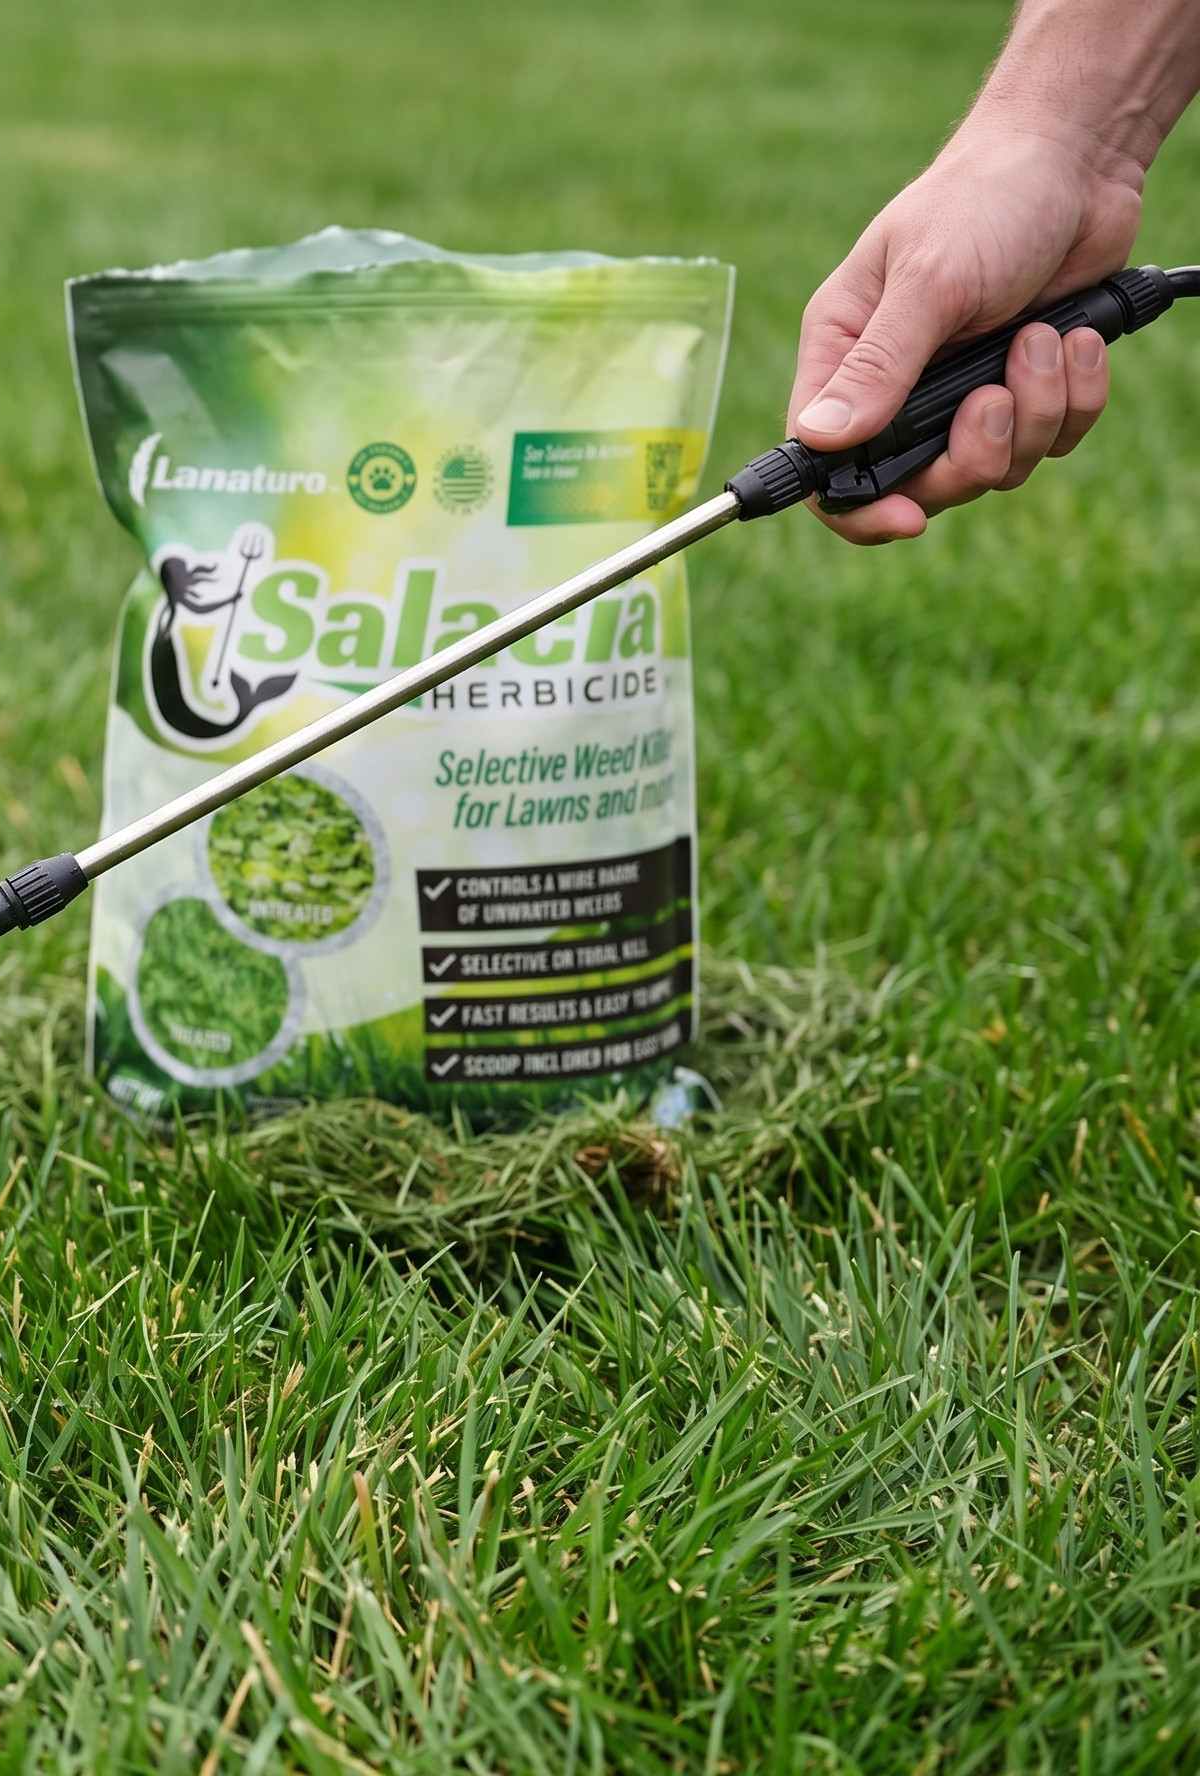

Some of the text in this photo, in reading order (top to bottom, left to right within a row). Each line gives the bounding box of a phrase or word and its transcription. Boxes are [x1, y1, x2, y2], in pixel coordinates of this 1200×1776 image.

[152, 454, 327, 495] Lanaturo
[433, 667, 658, 711] HERBICIDE
[435, 746, 567, 787] Selective
[573, 736, 638, 779] Weed
[453, 792, 499, 829] for
[504, 793, 590, 827] Lawns
[596, 780, 639, 820] and
[456, 873, 542, 898] CONTROLS
[543, 875, 555, 893] A
[457, 903, 480, 925] OF
[460, 952, 550, 976] SELECTIVE
[461, 1004, 505, 1027] FAST
[508, 999, 578, 1024] RESULTS
[594, 991, 630, 1013] EASY
[463, 1053, 521, 1077] SCOOP
